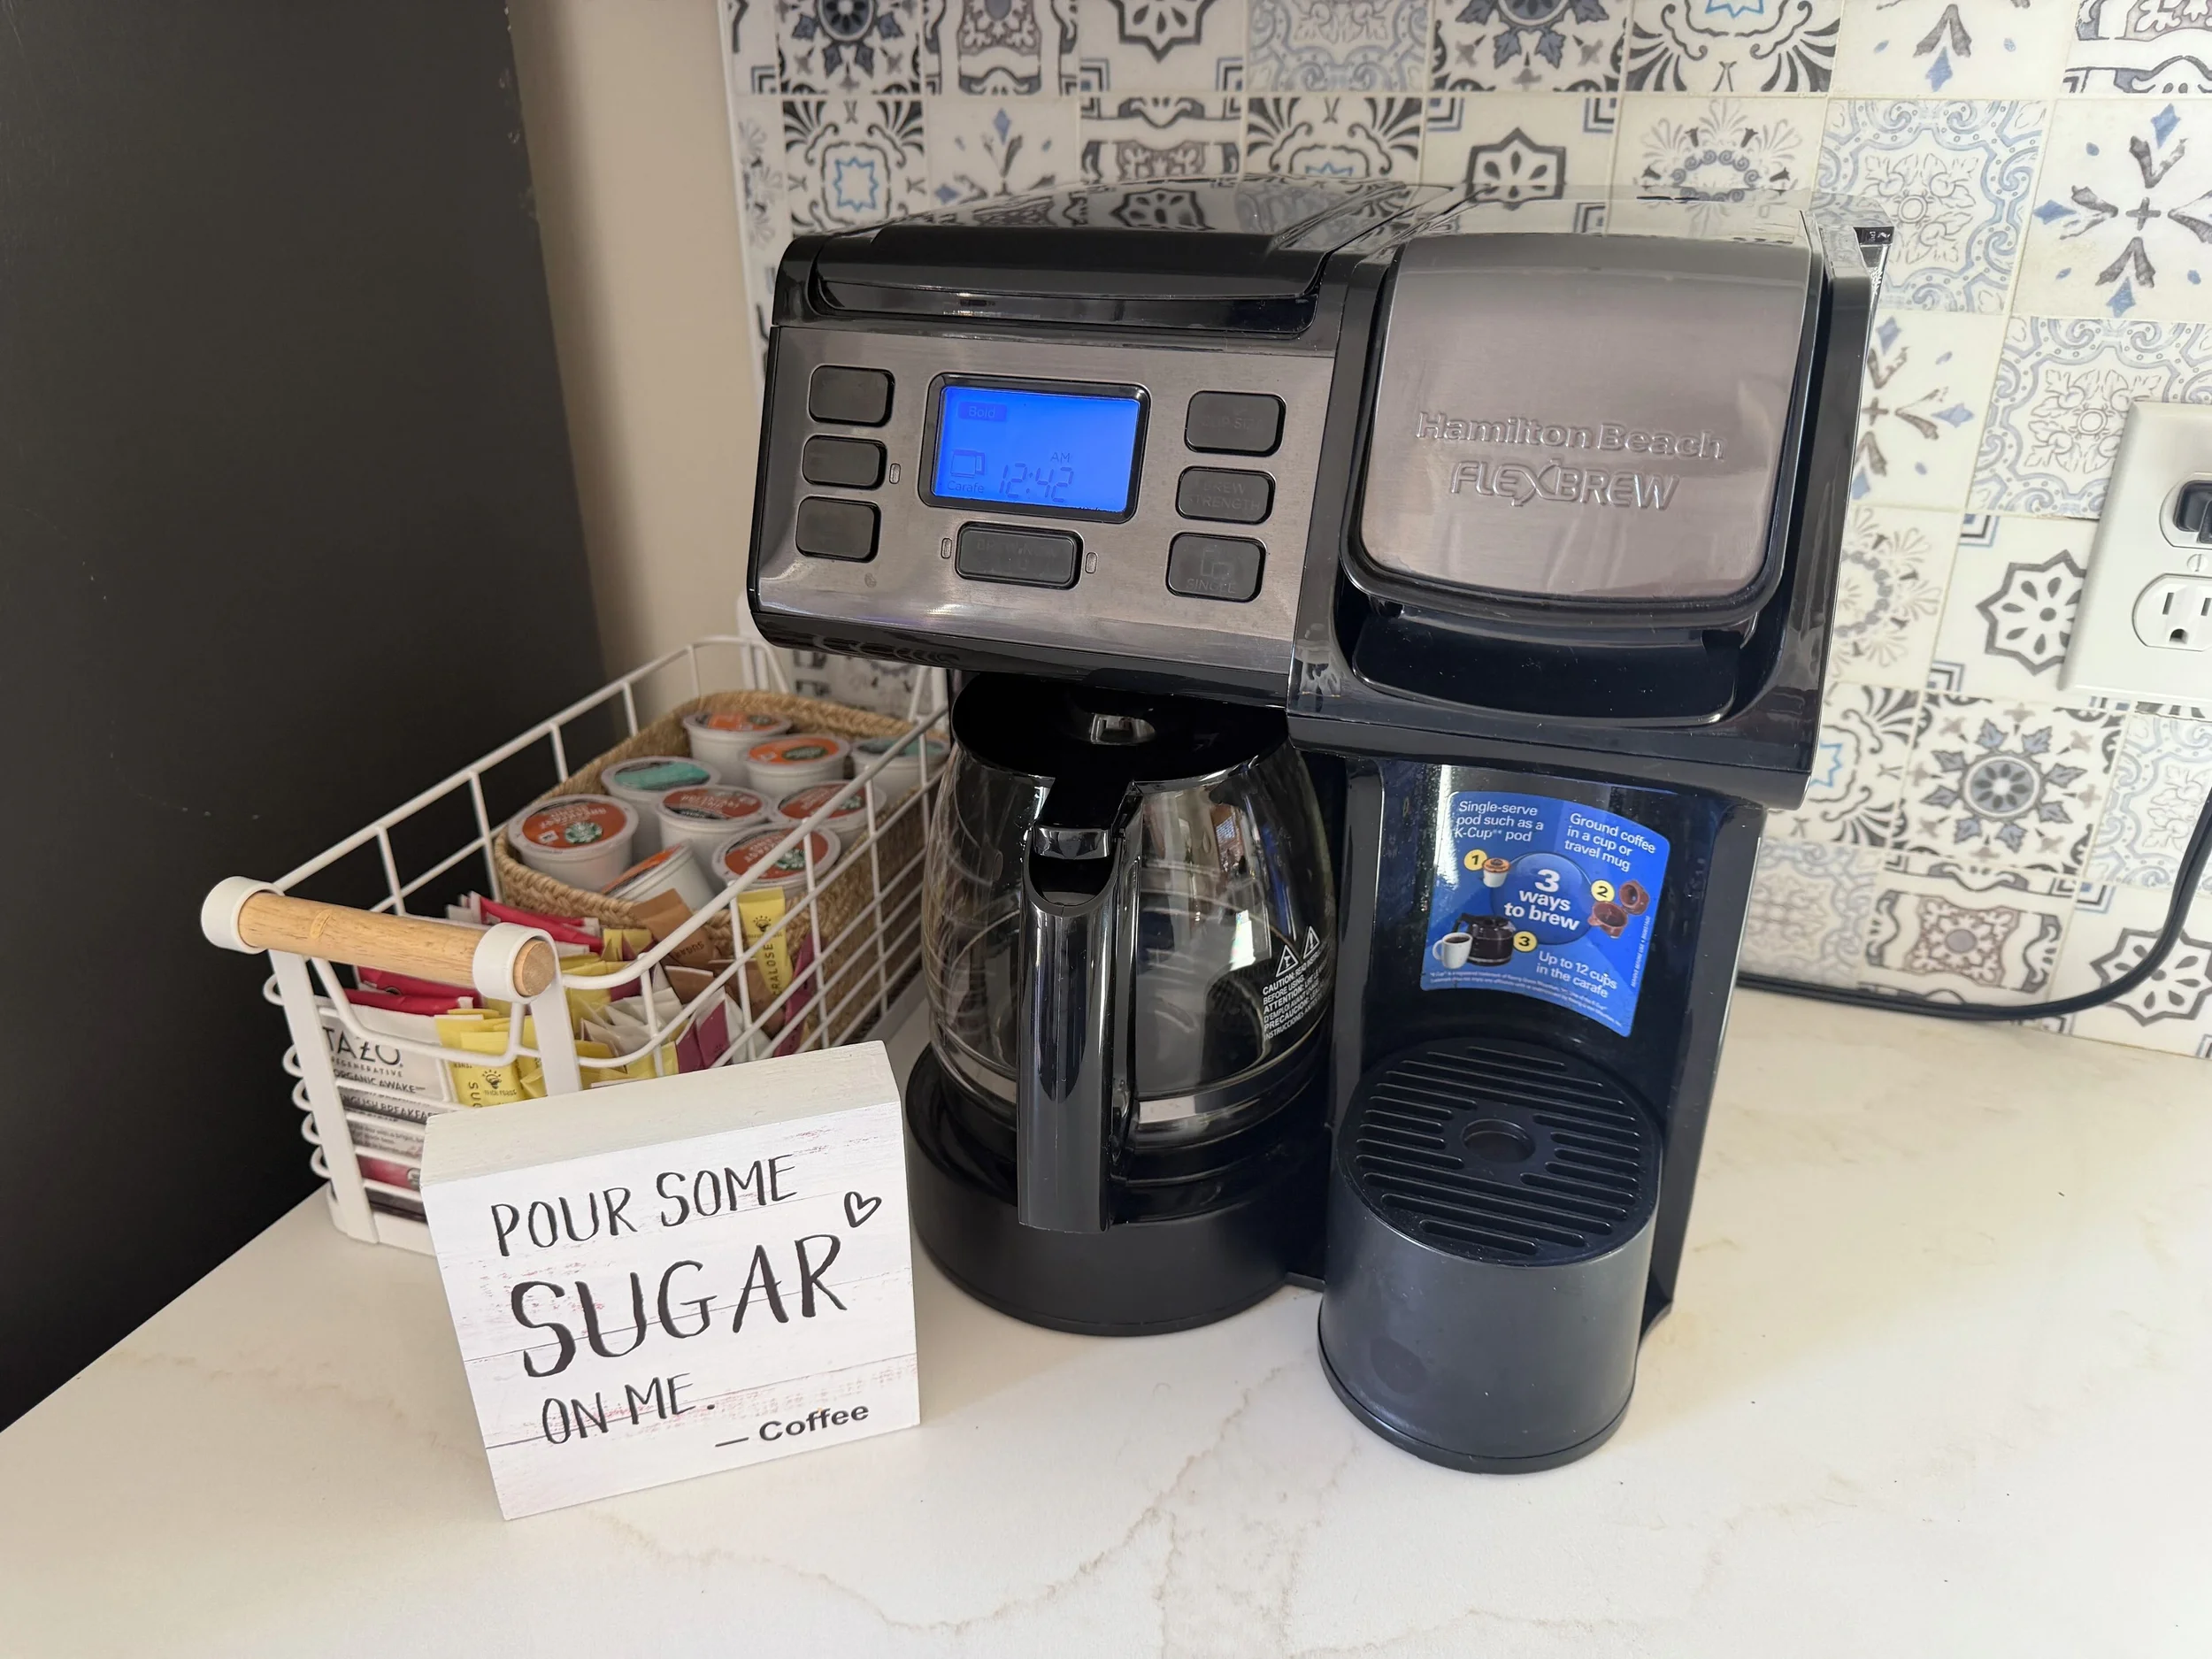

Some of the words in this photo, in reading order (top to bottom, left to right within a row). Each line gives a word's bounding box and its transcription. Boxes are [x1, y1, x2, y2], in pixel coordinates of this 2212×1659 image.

[968, 405, 995, 419] Bold
[1416, 411, 1592, 449] Hamilton
[1596, 422, 1725, 462] Beach
[1050, 452, 1071, 464] AM
[947, 480, 985, 494] Carafe
[999, 463, 1074, 503] 12:42
[1450, 457, 1679, 511] FLEXBREW
[1185, 578, 1237, 595] SINGLE
[1458, 800, 1538, 816] Single-serve
[1456, 814, 1481, 827] pod
[1483, 815, 1514, 826] such
[1517, 819, 1532, 829] as
[1535, 821, 1544, 831] a
[1570, 813, 1618, 837] Ground
[1620, 831, 1656, 854] coffee
[1505, 830, 1532, 841] pod
[1567, 826, 1579, 838] in
[1581, 832, 1590, 841] a
[1593, 835, 1617, 851] cup
[1618, 845, 1632, 856] or
[1471, 855, 1479, 865] 1
[1564, 840, 1600, 858] travel
[1601, 852, 1631, 872] mug
[1534, 869, 1560, 893] 3
[1596, 886, 1609, 898] 2
[1519, 890, 1571, 911] ways
[1504, 902, 1525, 918] to
[1528, 904, 1580, 931] brew
[1518, 936, 1531, 948] 3
[1536, 963, 1549, 974] in
[1550, 966, 1570, 982] the
[1571, 975, 1609, 998] carafe
[1539, 950, 1557, 965] Up
[1560, 957, 1573, 970] to
[1575, 962, 1589, 974] 12
[1589, 969, 1618, 990] cups
[1263, 972, 1294, 995] CAUTION:
[1263, 987, 1287, 1005] BEFORE
[1263, 985, 1303, 1014] ATTENTION:
[333, 1068, 376, 1087] ORGANIC
[491, 1187, 637, 1256] POUR
[657, 1154, 797, 1226] SOME
[511, 1234, 848, 1377] SUGAR
[541, 1392, 609, 1444] ON
[759, 1405, 869, 1441] Coffee
